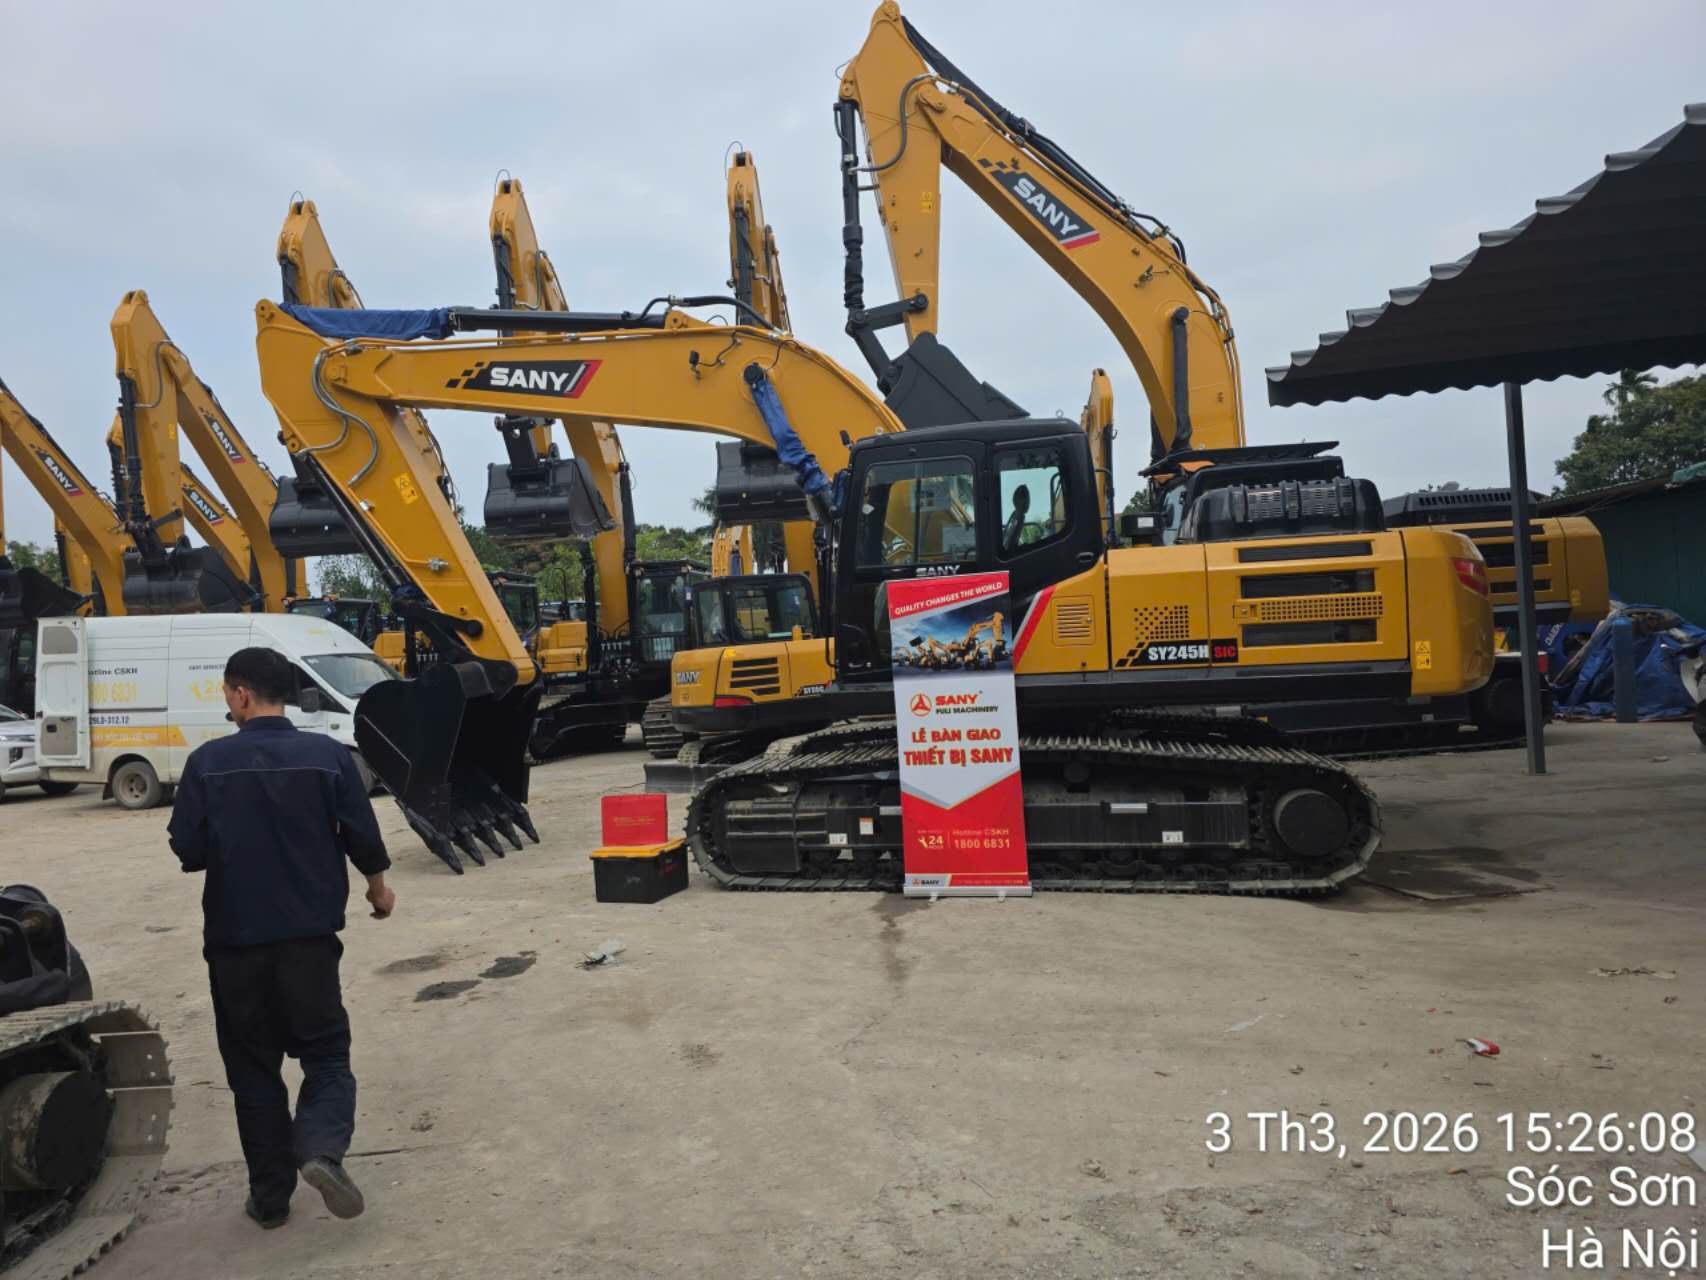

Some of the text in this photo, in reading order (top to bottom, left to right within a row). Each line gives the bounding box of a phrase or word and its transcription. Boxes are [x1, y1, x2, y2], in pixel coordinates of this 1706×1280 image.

[1013, 178, 1080, 235] SANY
[490, 367, 569, 391] SANY
[211, 419, 236, 461] SANY
[43, 457, 73, 490] SANY
[191, 490, 217, 520] SANY
[916, 565, 960, 576] SANY
[895, 582, 1003, 615] QUALITY CHANGES THE WORLD
[1148, 645, 1209, 661] SY245H
[88, 668, 111, 676] otline
[935, 694, 978, 706] SANY
[931, 728, 961, 742] BÀN
[966, 728, 1001, 740] GIAO
[904, 745, 1013, 767] THIẾT BỊ SANY
[928, 835, 943, 845] 24
[954, 838, 1010, 849] 1800 6831
